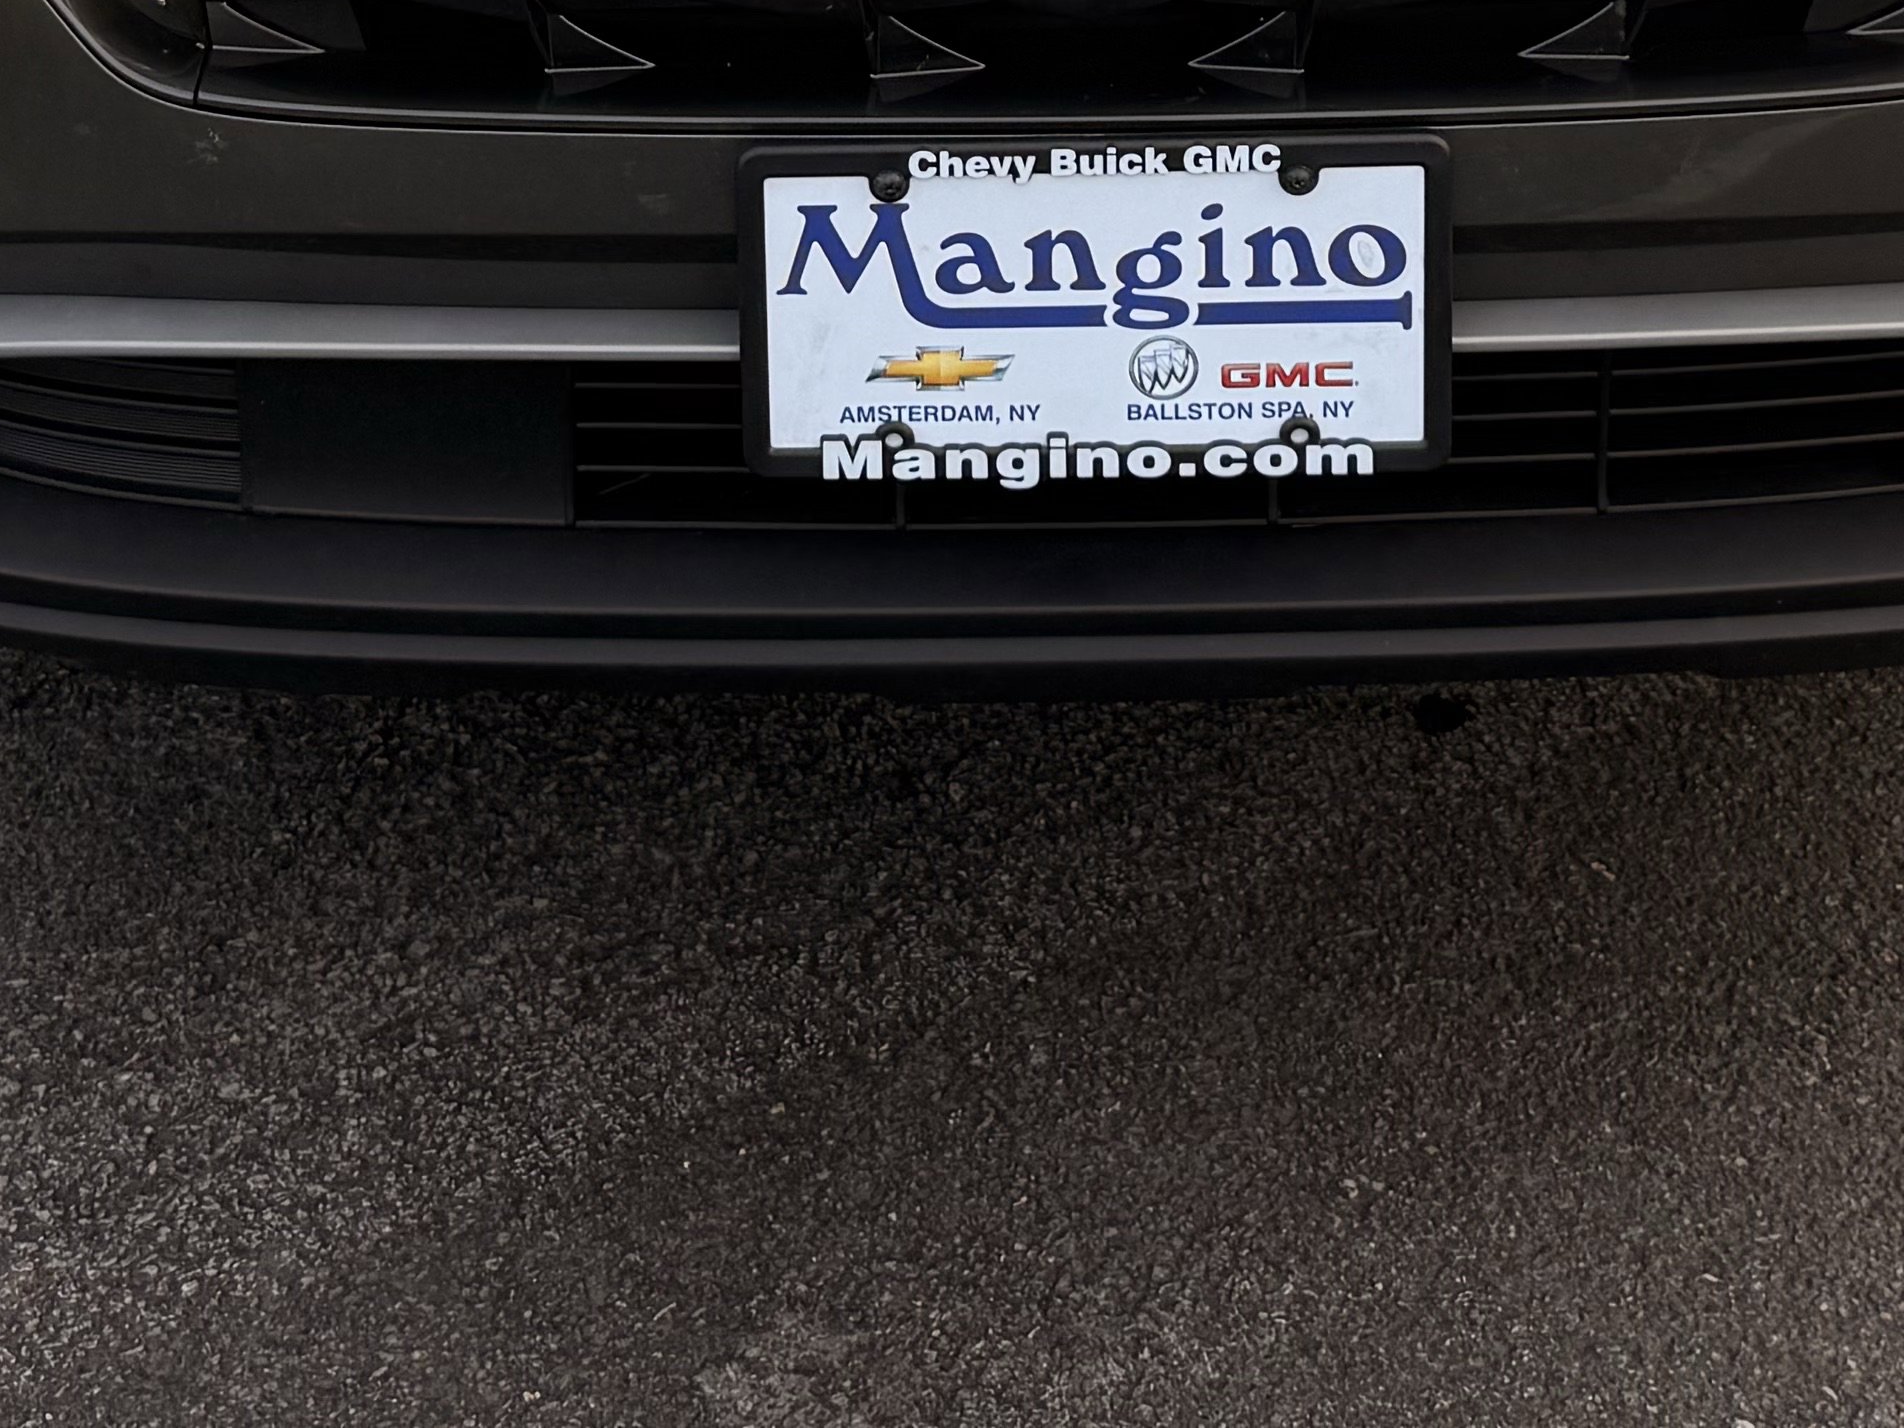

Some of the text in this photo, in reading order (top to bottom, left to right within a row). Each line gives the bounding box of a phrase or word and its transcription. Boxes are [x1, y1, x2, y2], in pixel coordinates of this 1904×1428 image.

[908, 143, 1282, 185] Chevy Buick GMC
[776, 202, 1412, 330] Mangino
[1220, 360, 1354, 389] GMC
[839, 403, 1041, 425] AMSTERDAM, NY
[1127, 401, 1253, 421] BALLSTON
[1322, 400, 1355, 419] NY
[821, 436, 1374, 491] Mangino.com
